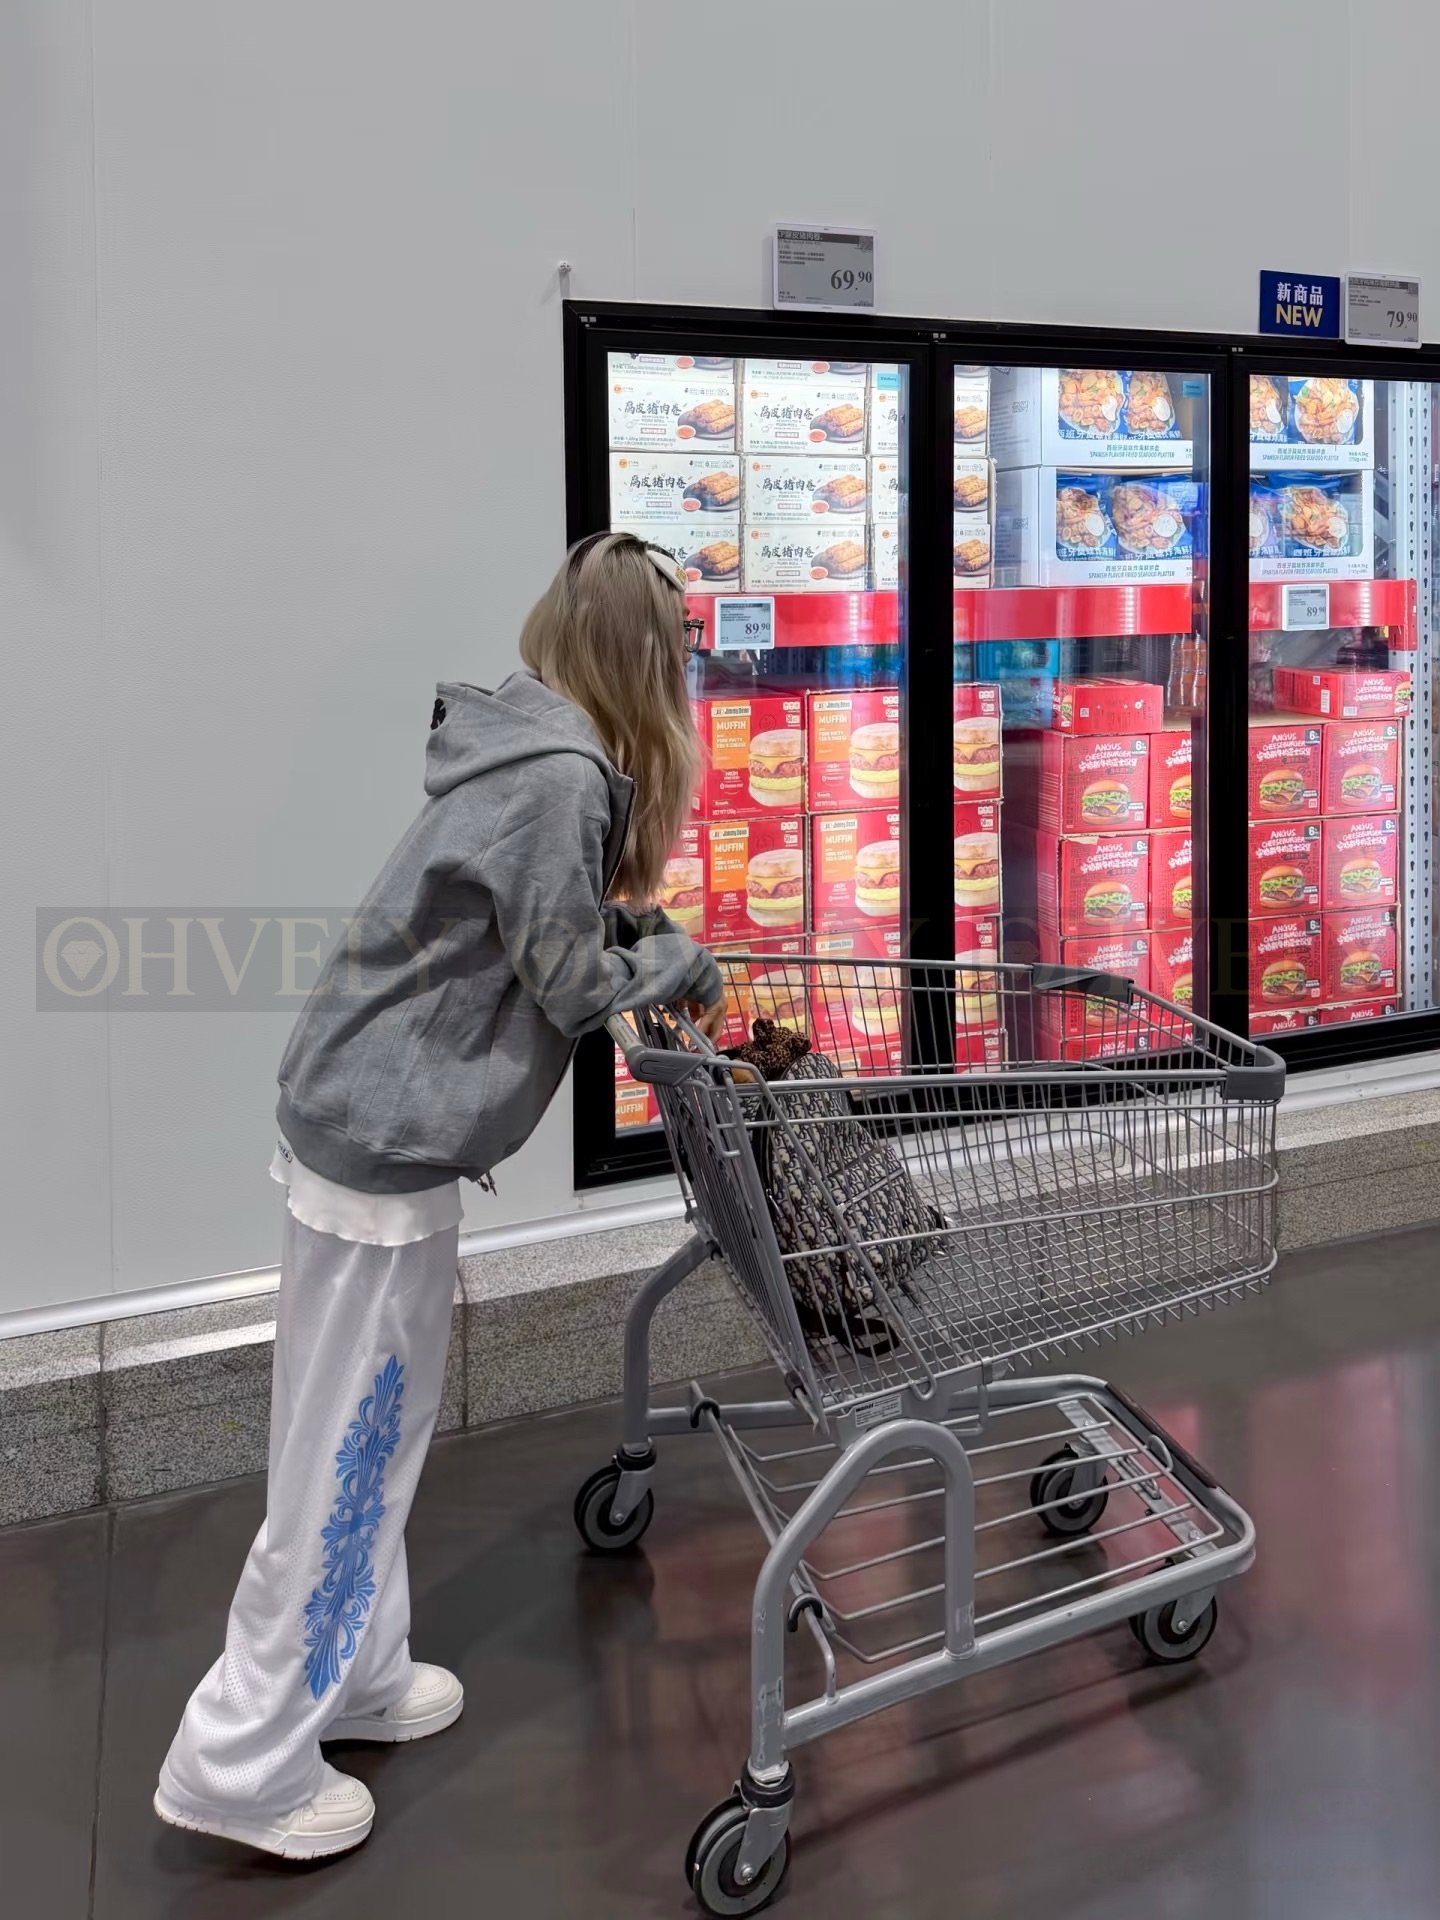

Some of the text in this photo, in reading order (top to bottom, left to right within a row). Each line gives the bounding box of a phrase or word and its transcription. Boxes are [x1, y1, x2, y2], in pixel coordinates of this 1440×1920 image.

[831, 269, 872, 290] 69.90
[1277, 282, 1323, 306] 新商品
[1276, 304, 1323, 327] NEW
[1386, 311, 1418, 328] 79.90
[745, 622, 771, 635] 89.90
[819, 715, 847, 724] MUFFIN
[716, 721, 746, 730] MUFFIN
[1271, 733, 1296, 742] ANGUS
[1353, 729, 1375, 738] ANGUS
[1095, 743, 1121, 751] ANGUS
[1351, 823, 1374, 831] ANGUS
[1270, 829, 1296, 839] ANGUS
[825, 835, 852, 845] MUFFIN
[715, 843, 744, 853] MUFFIN
[1096, 843, 1123, 853] ANGUS
[1272, 923, 1297, 933] ANGUS
[1097, 944, 1123, 953] ANGUS
[1351, 1009, 1374, 1019] ANGUS
[1271, 1020, 1296, 1031] ANGUS
